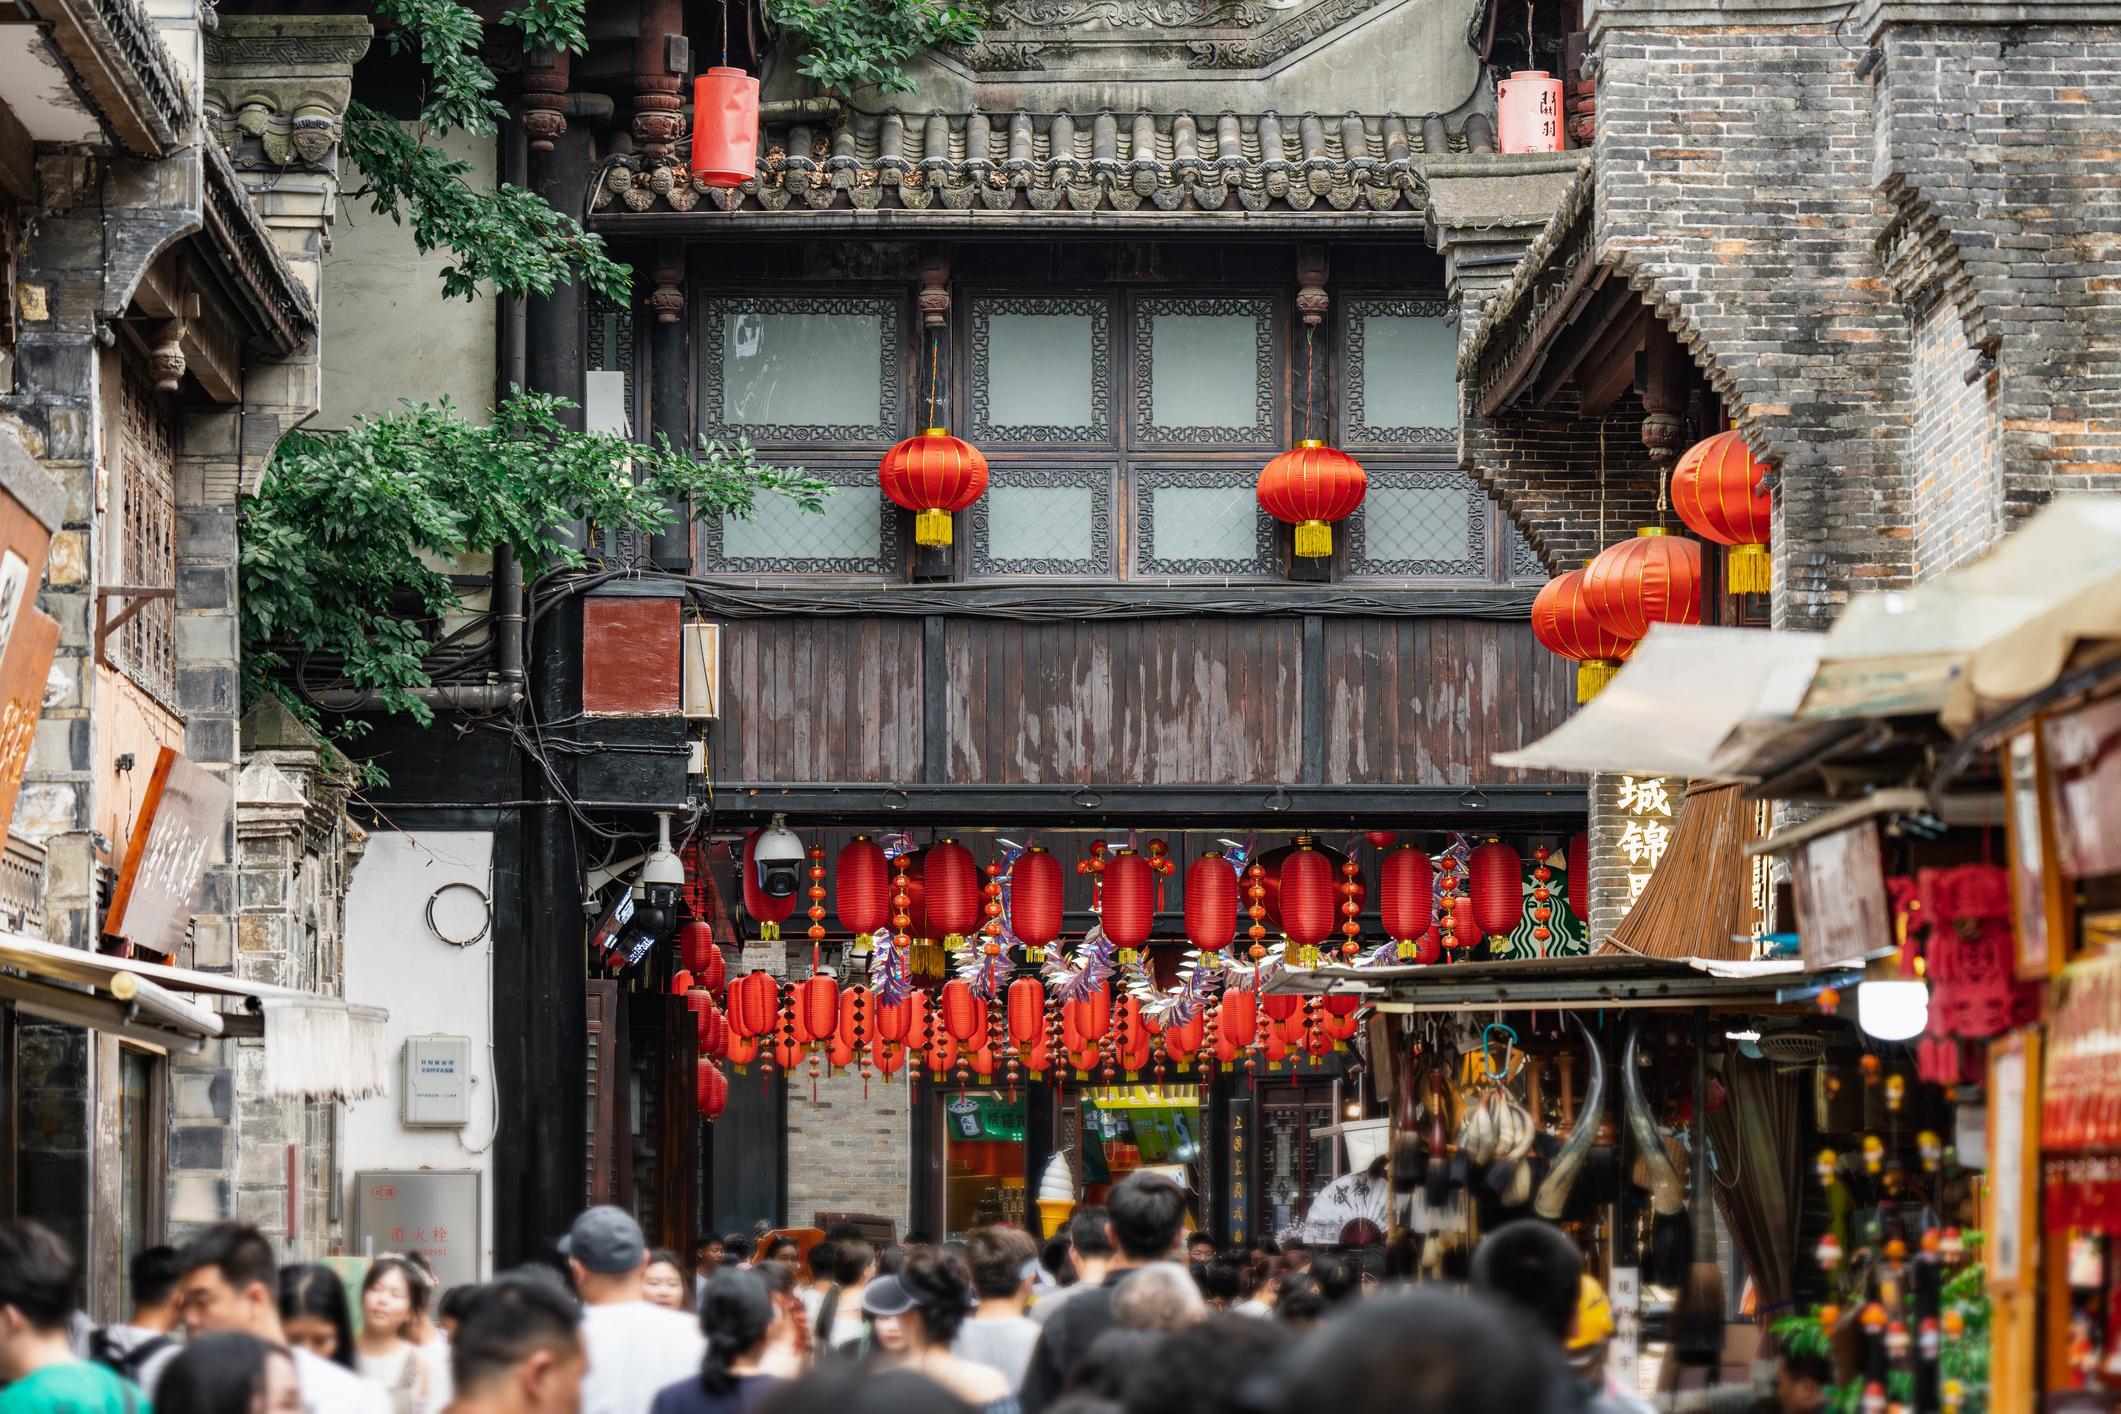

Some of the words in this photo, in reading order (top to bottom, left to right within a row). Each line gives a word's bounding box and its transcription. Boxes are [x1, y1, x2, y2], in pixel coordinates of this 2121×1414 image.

[1540, 91, 1556, 136] 關羽
[391, 1227, 447, 1242] 消火栓
